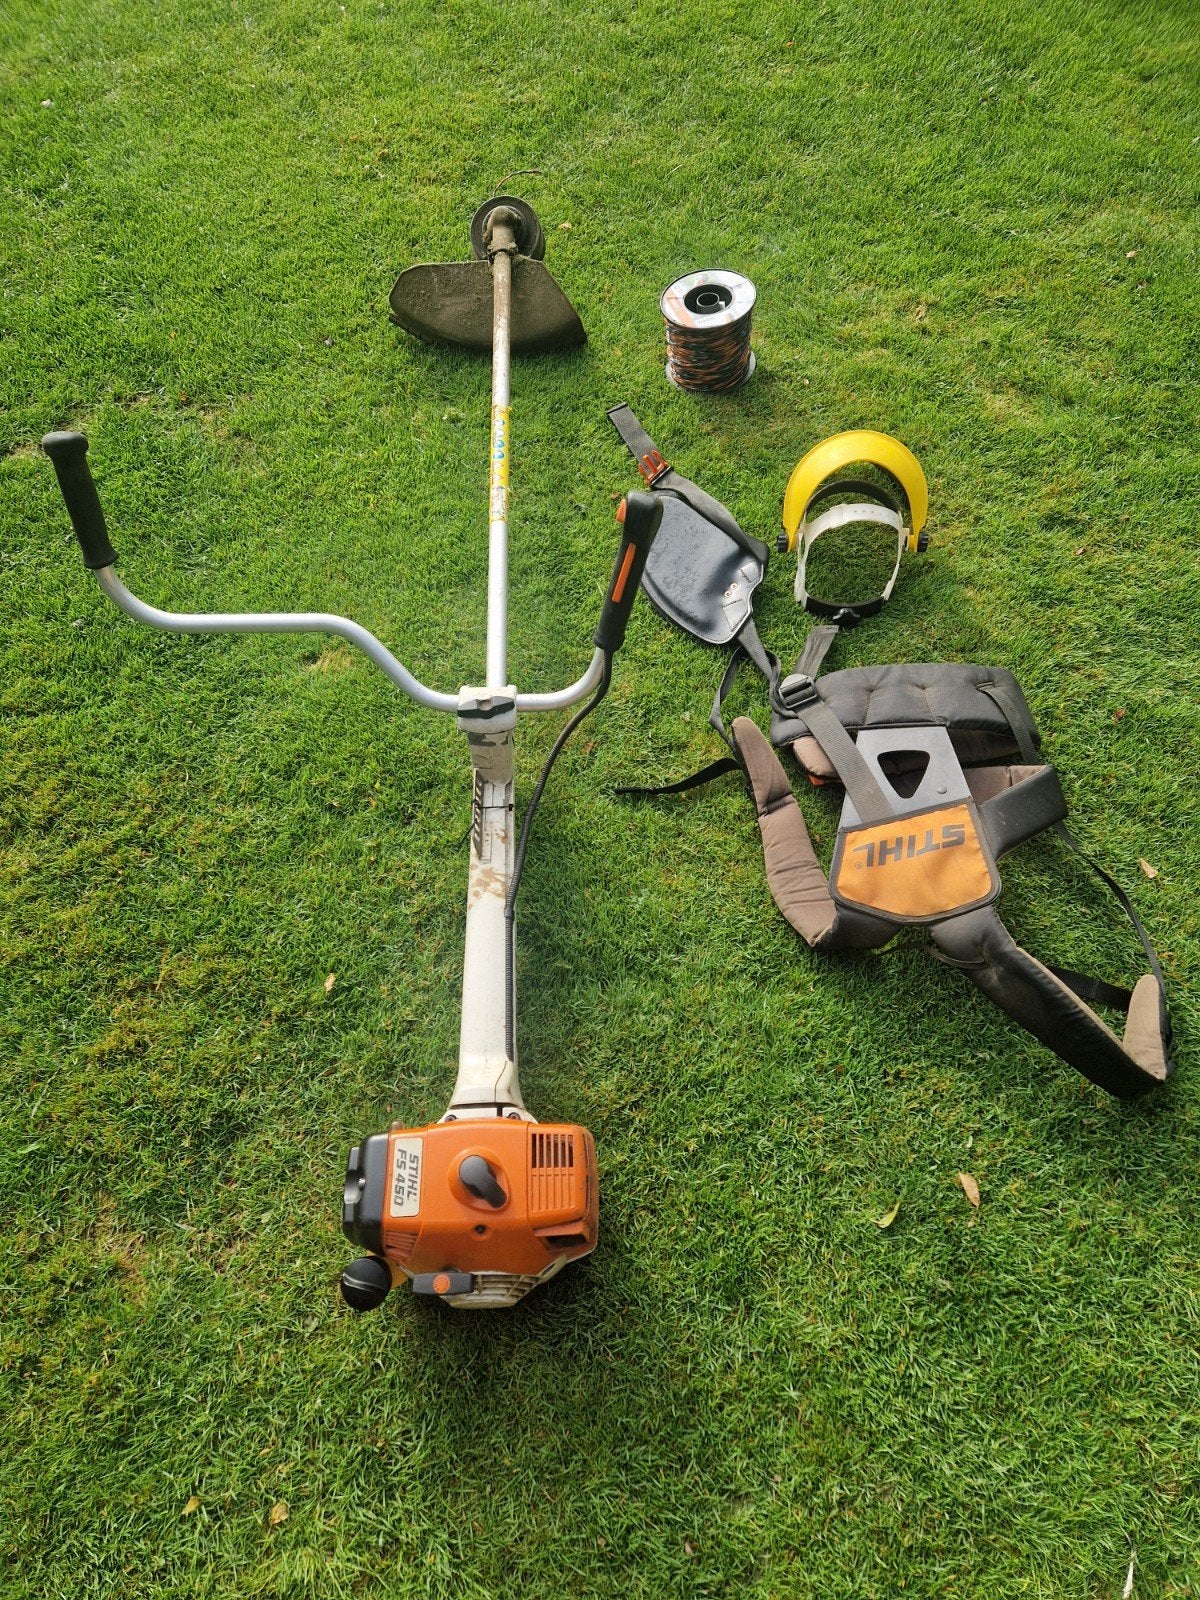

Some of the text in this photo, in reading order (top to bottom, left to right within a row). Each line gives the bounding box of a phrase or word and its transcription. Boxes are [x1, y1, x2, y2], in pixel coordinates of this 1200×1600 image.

[852, 823, 966, 868] STIHL
[393, 1148, 408, 1207] FS 450
[406, 1153, 420, 1200] STIHL
